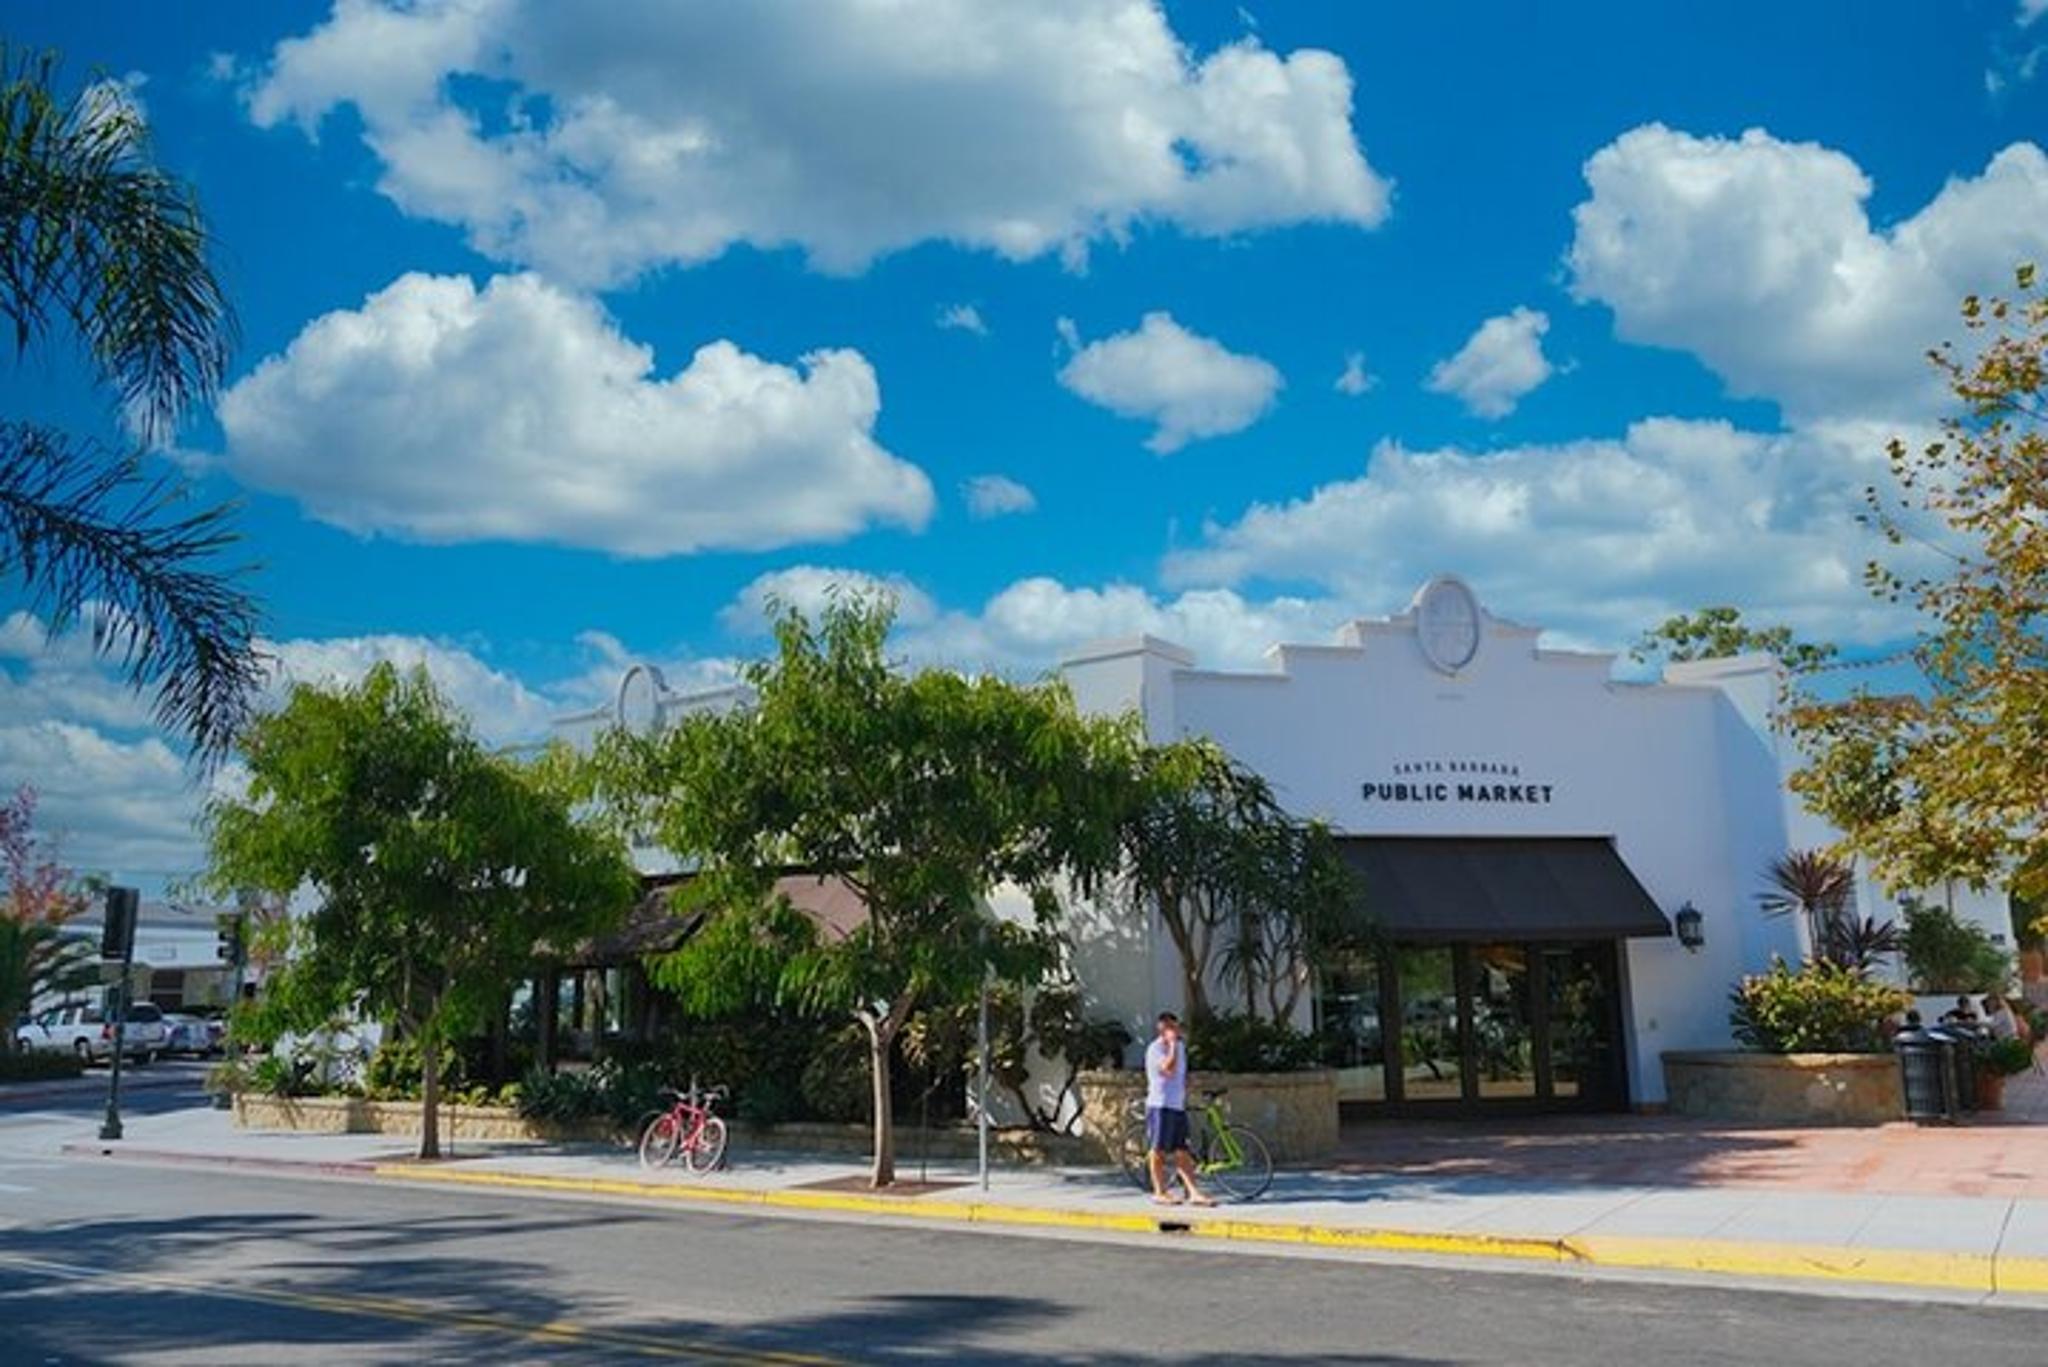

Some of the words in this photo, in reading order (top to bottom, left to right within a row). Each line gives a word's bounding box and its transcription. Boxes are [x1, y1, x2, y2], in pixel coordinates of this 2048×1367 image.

[1393, 761, 1442, 775] SANTA
[1450, 761, 1519, 776] BARBARA
[1362, 783, 1448, 801] PUBLIC
[1457, 784, 1553, 803] MARKET
